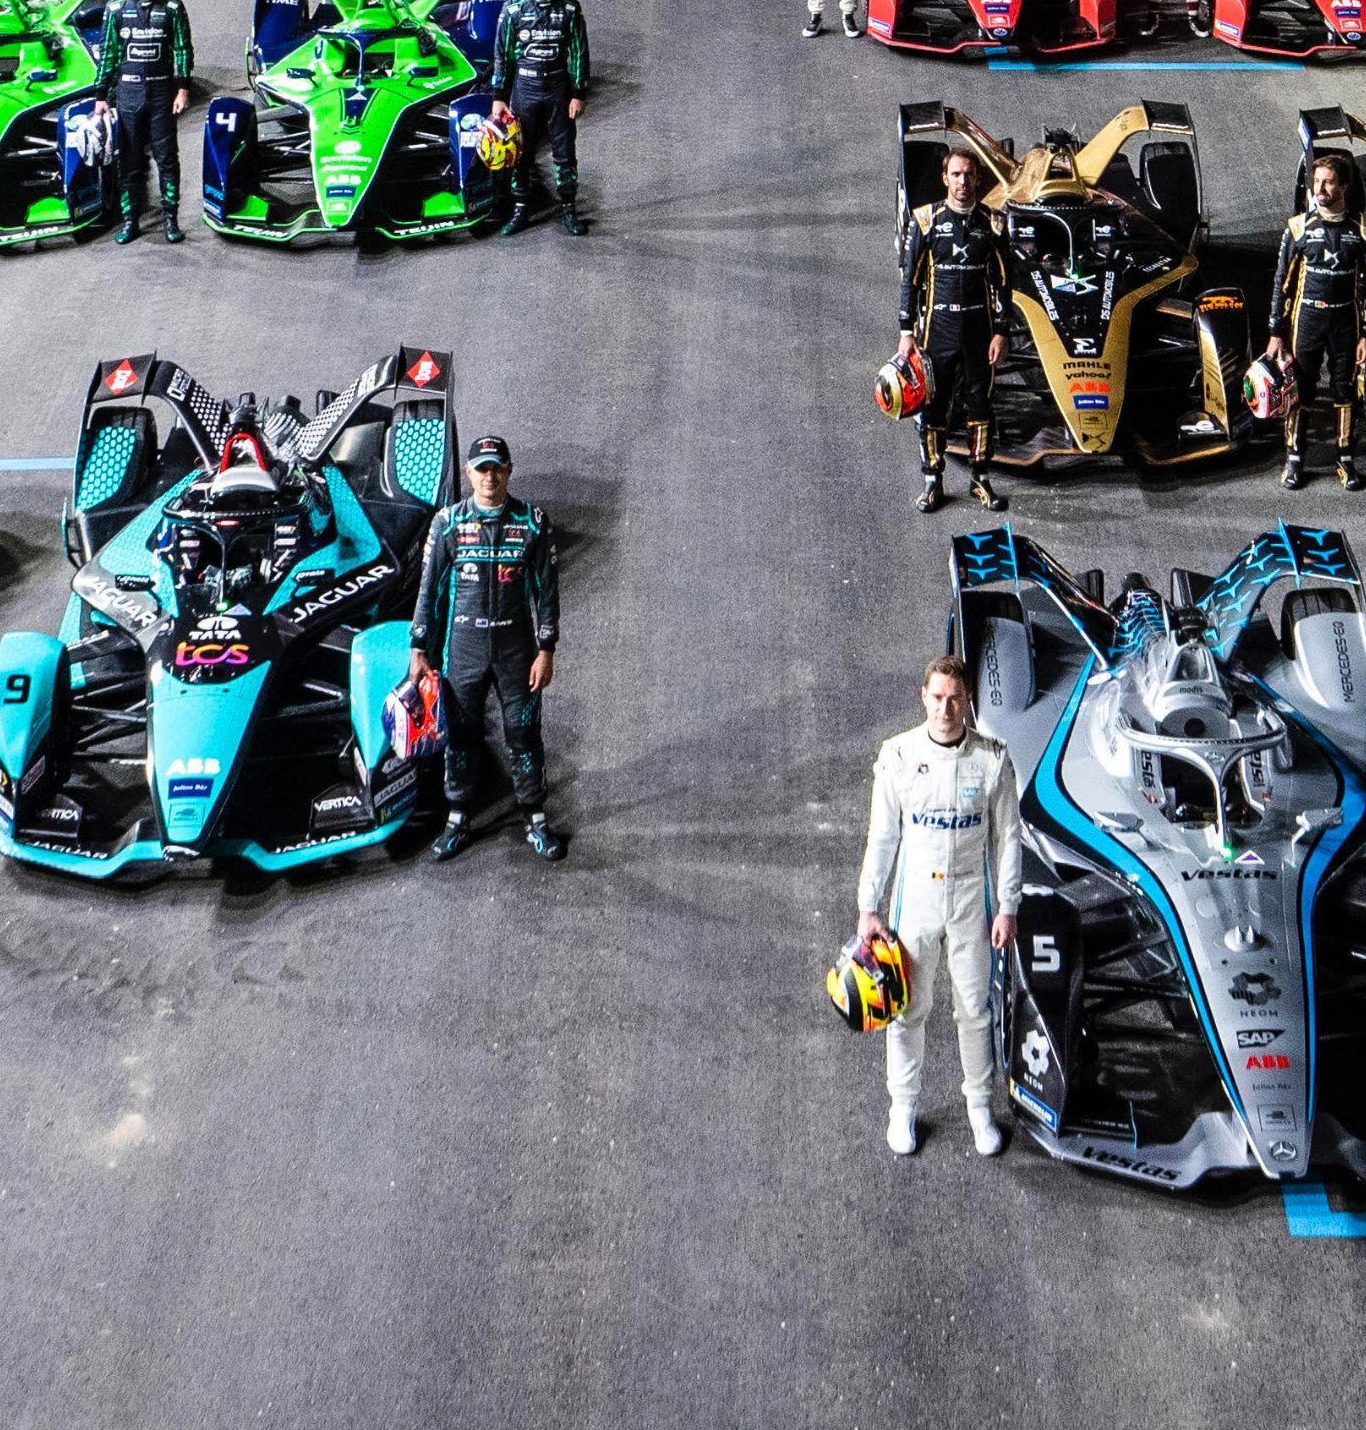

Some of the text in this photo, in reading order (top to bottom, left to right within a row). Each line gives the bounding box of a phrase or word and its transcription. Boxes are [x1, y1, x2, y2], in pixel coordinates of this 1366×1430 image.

[1330, 0, 1363, 8] ABB
[215, 112, 237, 132] 4
[1063, 361, 1111, 370] MAHLE
[1069, 381, 1110, 394] ABB
[456, 548, 525, 558] JAGUAR
[80, 574, 158, 628] JAGUAR
[292, 564, 396, 624] JAGUAR
[188, 630, 242, 641] TATA
[175, 641, 250, 667] tcs
[2, 673, 32, 705] 9
[1179, 686, 1203, 694] modis
[165, 757, 221, 776] ABB
[313, 795, 363, 813] VERTICA
[911, 810, 983, 830] Vestas
[1032, 935, 1061, 972] 5
[1239, 1009, 1278, 1017] NEOM
[1237, 1032, 1276, 1046] SAP
[1245, 1054, 1292, 1070] ABB
[1080, 1145, 1184, 1183] Vestas
